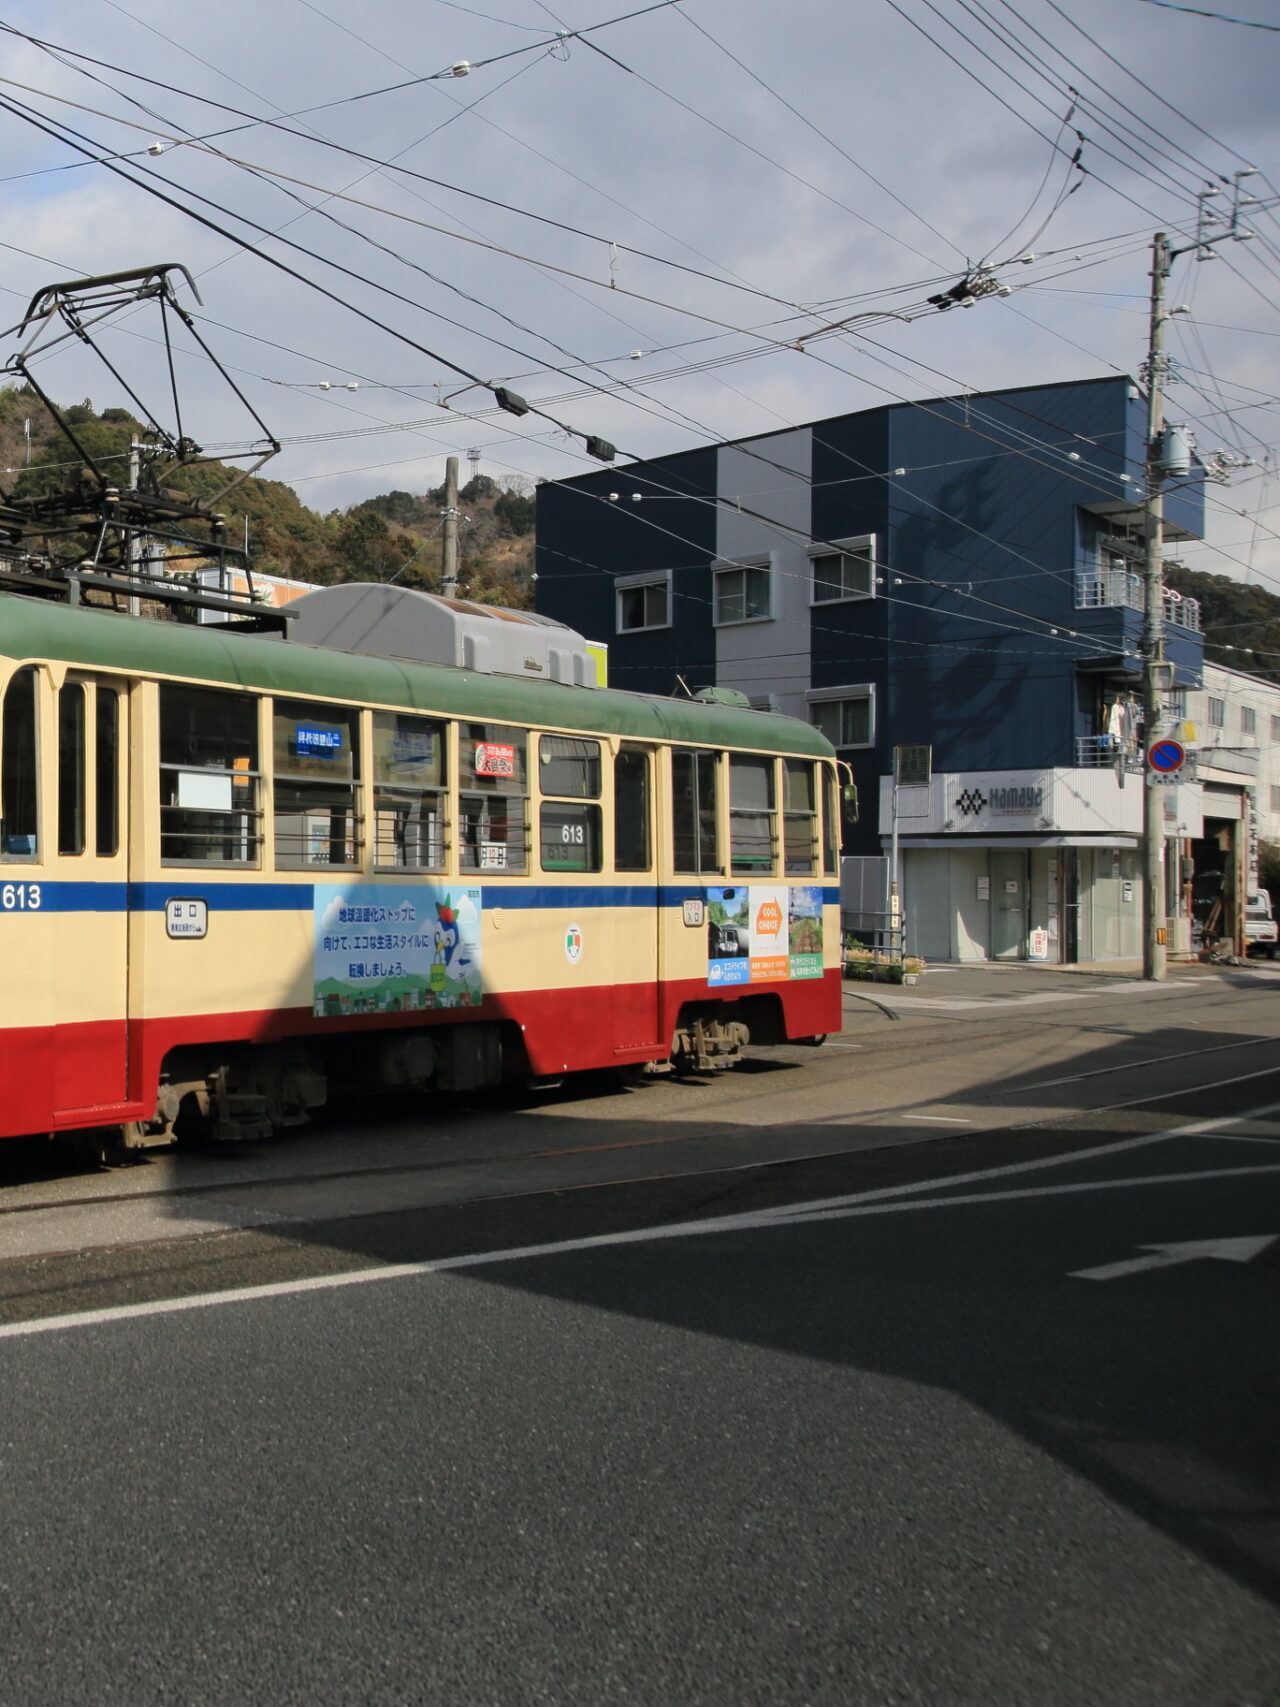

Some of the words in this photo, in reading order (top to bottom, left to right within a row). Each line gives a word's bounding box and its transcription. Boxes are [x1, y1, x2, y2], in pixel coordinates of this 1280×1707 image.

[561, 825, 583, 844] 613
[2, 884, 41, 909] 613
[174, 904, 197, 917] 出口
[339, 907, 416, 923] 地球温暖化ストップに
[762, 907, 778, 917] COOL
[759, 920, 778, 930] CHOICE
[323, 934, 429, 951] 向けて、エコな生活スタイルに
